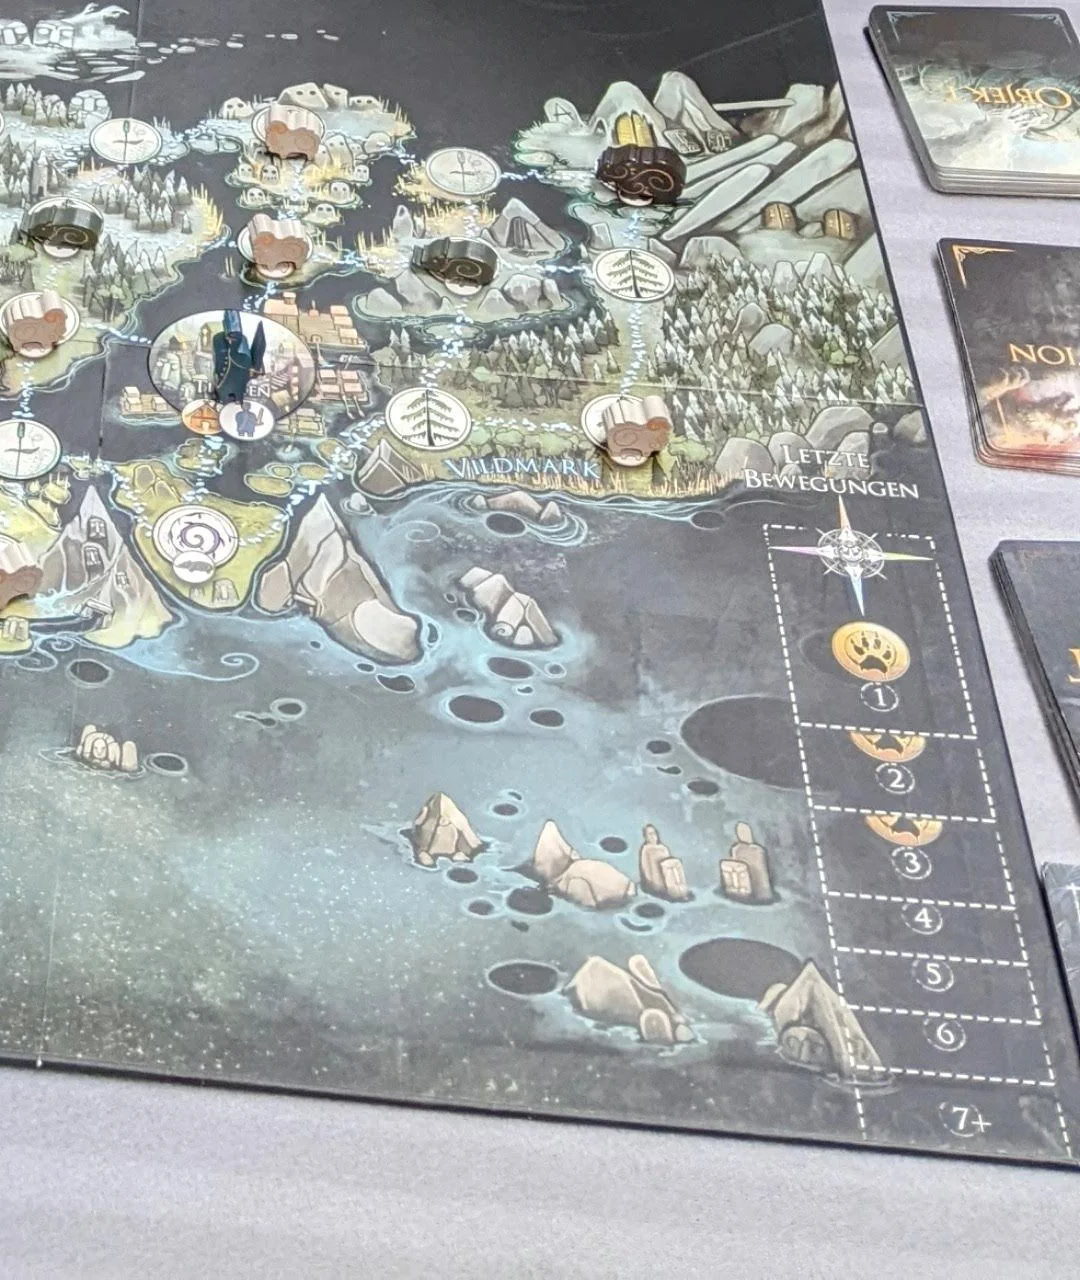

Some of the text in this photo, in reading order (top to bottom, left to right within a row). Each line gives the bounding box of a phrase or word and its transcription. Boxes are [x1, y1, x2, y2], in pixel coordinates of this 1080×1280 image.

[444, 456, 602, 480] VILDMARK
[781, 444, 871, 470] LETZTE
[743, 466, 920, 500] BEWEGUNGEN
[873, 685, 889, 707] 1
[887, 768, 904, 790] 2
[904, 850, 921, 874] 3
[914, 907, 933, 929] 4
[927, 961, 945, 986] 5
[937, 1022, 956, 1046] 6
[951, 1106, 992, 1134] 7+
